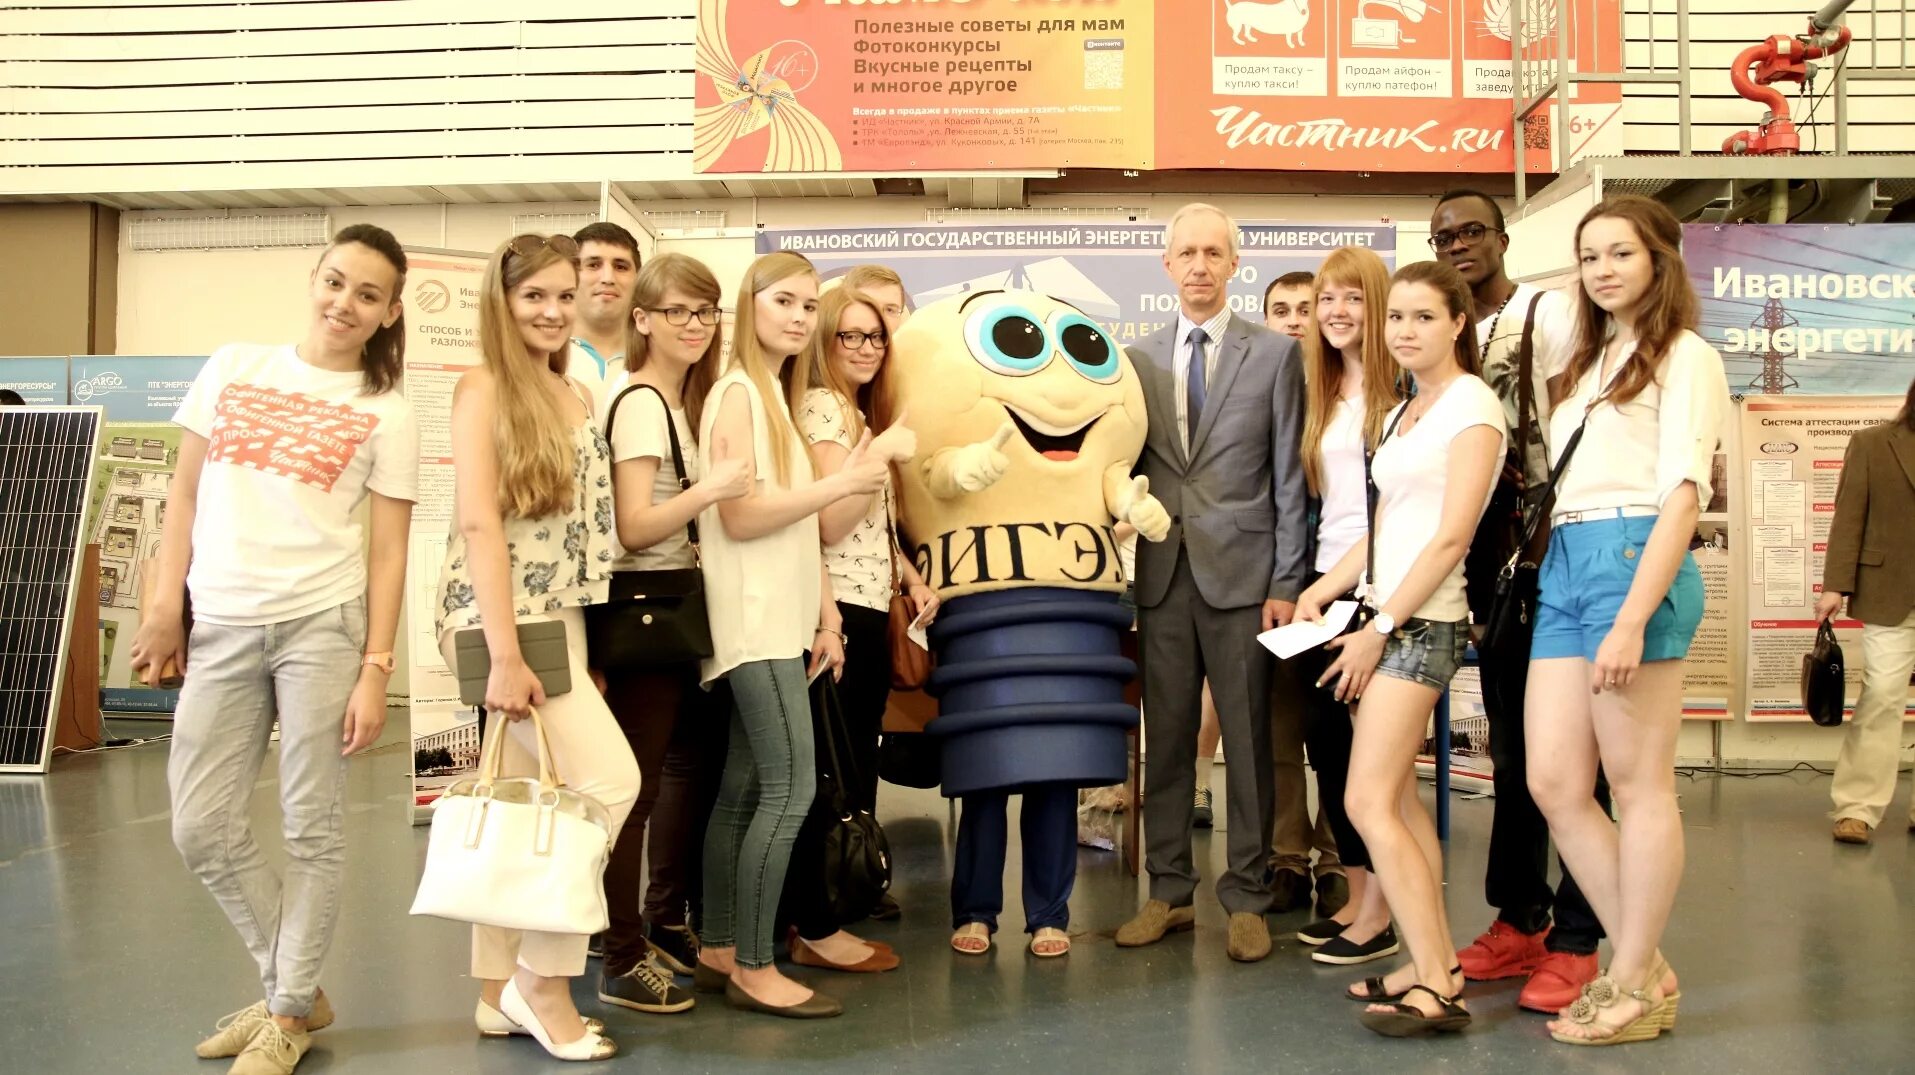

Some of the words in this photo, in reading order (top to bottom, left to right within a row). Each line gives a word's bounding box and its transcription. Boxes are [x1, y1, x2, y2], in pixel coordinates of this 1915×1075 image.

[854, 19, 955, 34] Полезные
[960, 20, 1031, 33] советы
[1036, 19, 1075, 34] для
[1082, 19, 1125, 31] мам
[853, 39, 1001, 56] Фотоконкурсы
[854, 59, 940, 76] Вкусные
[945, 60, 1032, 76] рецепты
[1224, 65, 1270, 75] Продам
[1272, 66, 1304, 77] таксу
[1345, 66, 1390, 76] Продам
[1393, 66, 1431, 77] айфон
[1475, 68, 1512, 78] Прода
[853, 82, 865, 93] и
[870, 81, 943, 93] многое
[948, 79, 1018, 95] другое
[1224, 79, 1261, 90] куплю
[1263, 79, 1300, 89] такси!
[1345, 80, 1382, 91] куплю
[1384, 80, 1438, 92] патефон!
[1475, 84, 1514, 94] заведу
[852, 107, 887, 116] Всегда
[897, 108, 941, 117] продаже
[951, 107, 990, 116] пунктах
[992, 107, 1030, 116] приема
[944, 117, 981, 126] Красной
[983, 117, 1015, 127] Армии,
[1028, 116, 1040, 124] 7А
[1013, 127, 1025, 135] 55
[1020, 137, 1036, 145] 141
[780, 231, 899, 250] ИВАНОВСКИЙ
[903, 228, 1082, 249] ГОСУДАРСТВЕННЫЙ
[1249, 231, 1375, 247] УНИВЕРСИТЕТ
[419, 325, 462, 335] СПОСОБ
[465, 328, 473, 336] И
[92, 376, 123, 386] ARGO
[225, 387, 304, 411] ОФИГЕННАЯ
[308, 406, 369, 424] РЕКЛАМА
[1761, 418, 1803, 427] Система
[1805, 419, 1861, 428] аттестации
[306, 431, 348, 455] ГАЗЕТЕ
